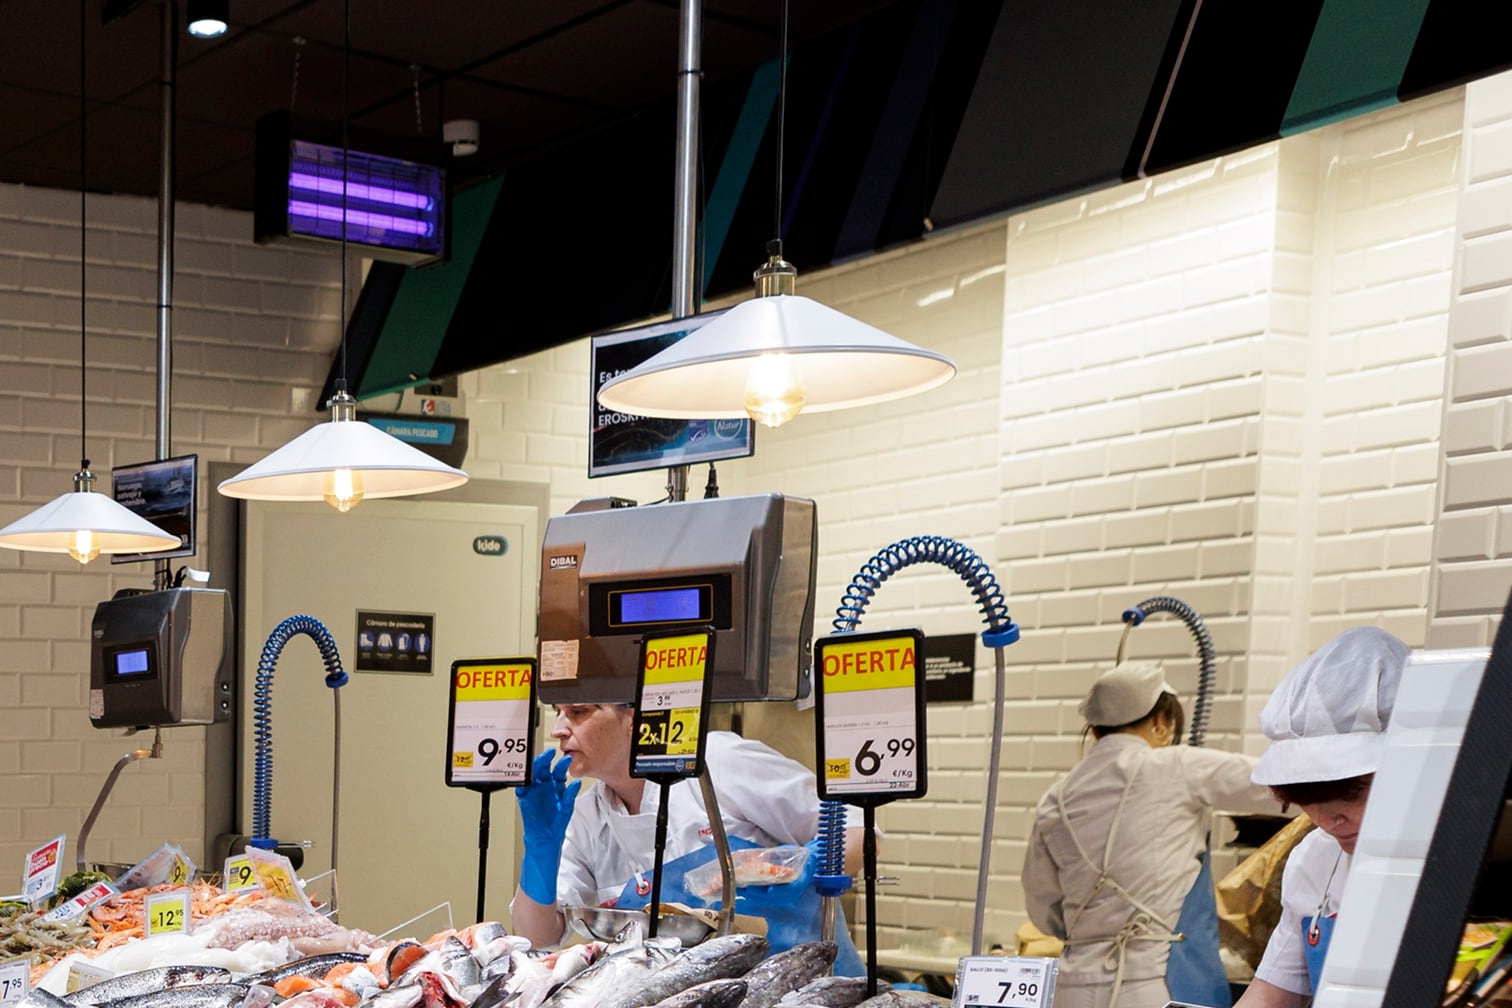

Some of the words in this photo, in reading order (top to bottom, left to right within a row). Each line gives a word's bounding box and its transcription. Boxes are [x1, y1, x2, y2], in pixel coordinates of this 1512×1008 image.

[550, 556, 577, 567] DIBAL
[644, 646, 707, 670] OFERTA
[822, 648, 915, 677] OFERTA
[456, 669, 531, 689] OFERTA
[478, 738, 526, 766] 9,95
[855, 738, 915, 776] 6,99
[892, 769, 913, 778] €/Kg
[2, 978, 23, 999] 7,95
[997, 981, 1038, 1004] 7,90
